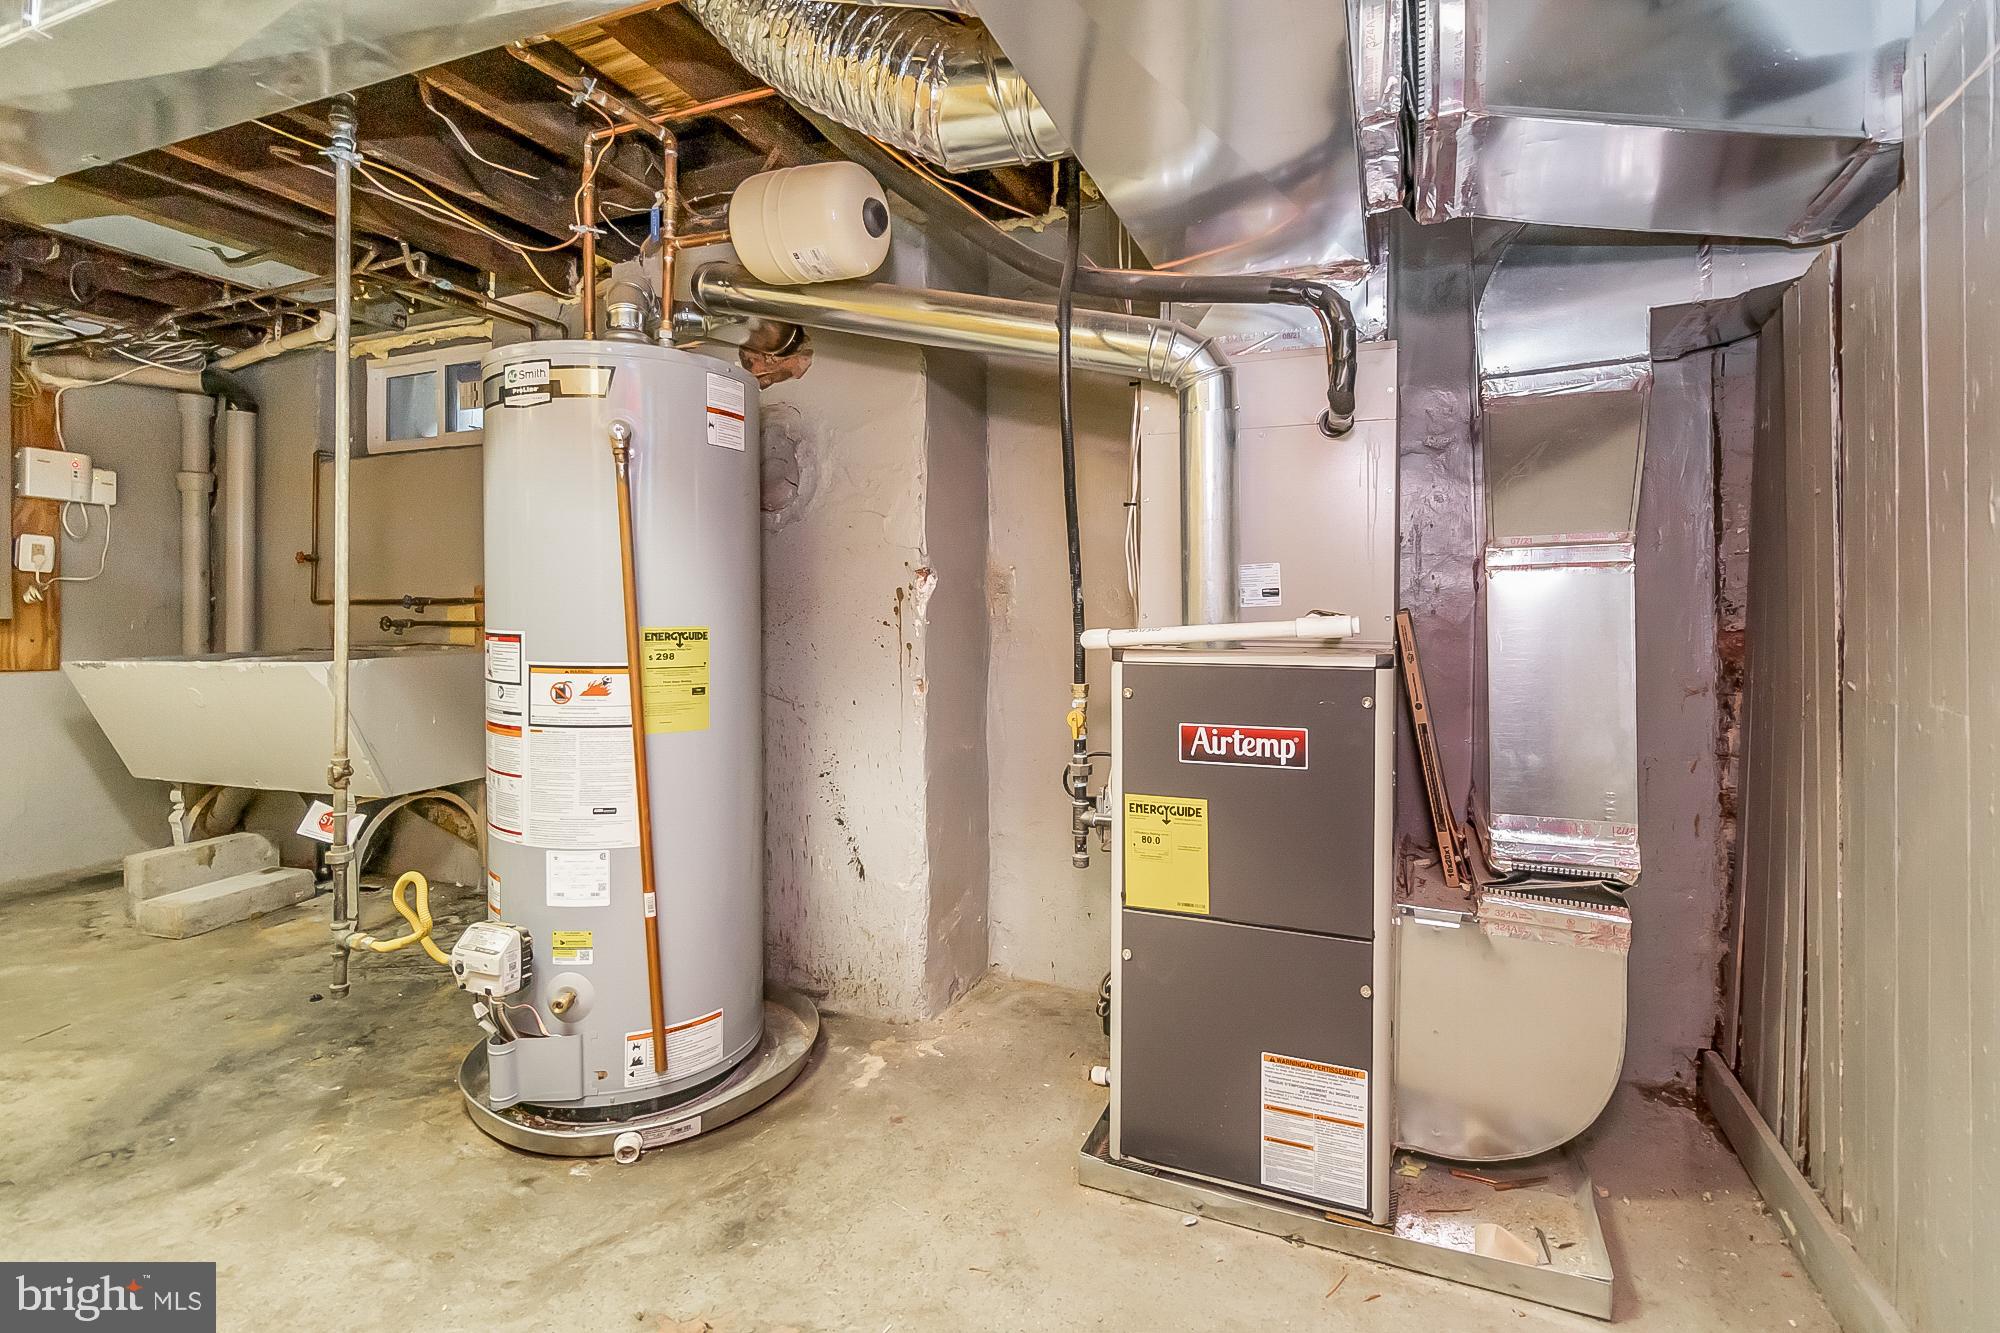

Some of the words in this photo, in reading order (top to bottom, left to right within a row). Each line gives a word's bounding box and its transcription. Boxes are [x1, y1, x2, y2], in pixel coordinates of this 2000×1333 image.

[519, 369, 546, 379] Smith
[656, 652, 675, 661] 298
[1190, 726, 1296, 766] Airtemp
[1129, 802, 1203, 819] ENERGYGUIDE
[1141, 835, 1161, 845] 80.0
